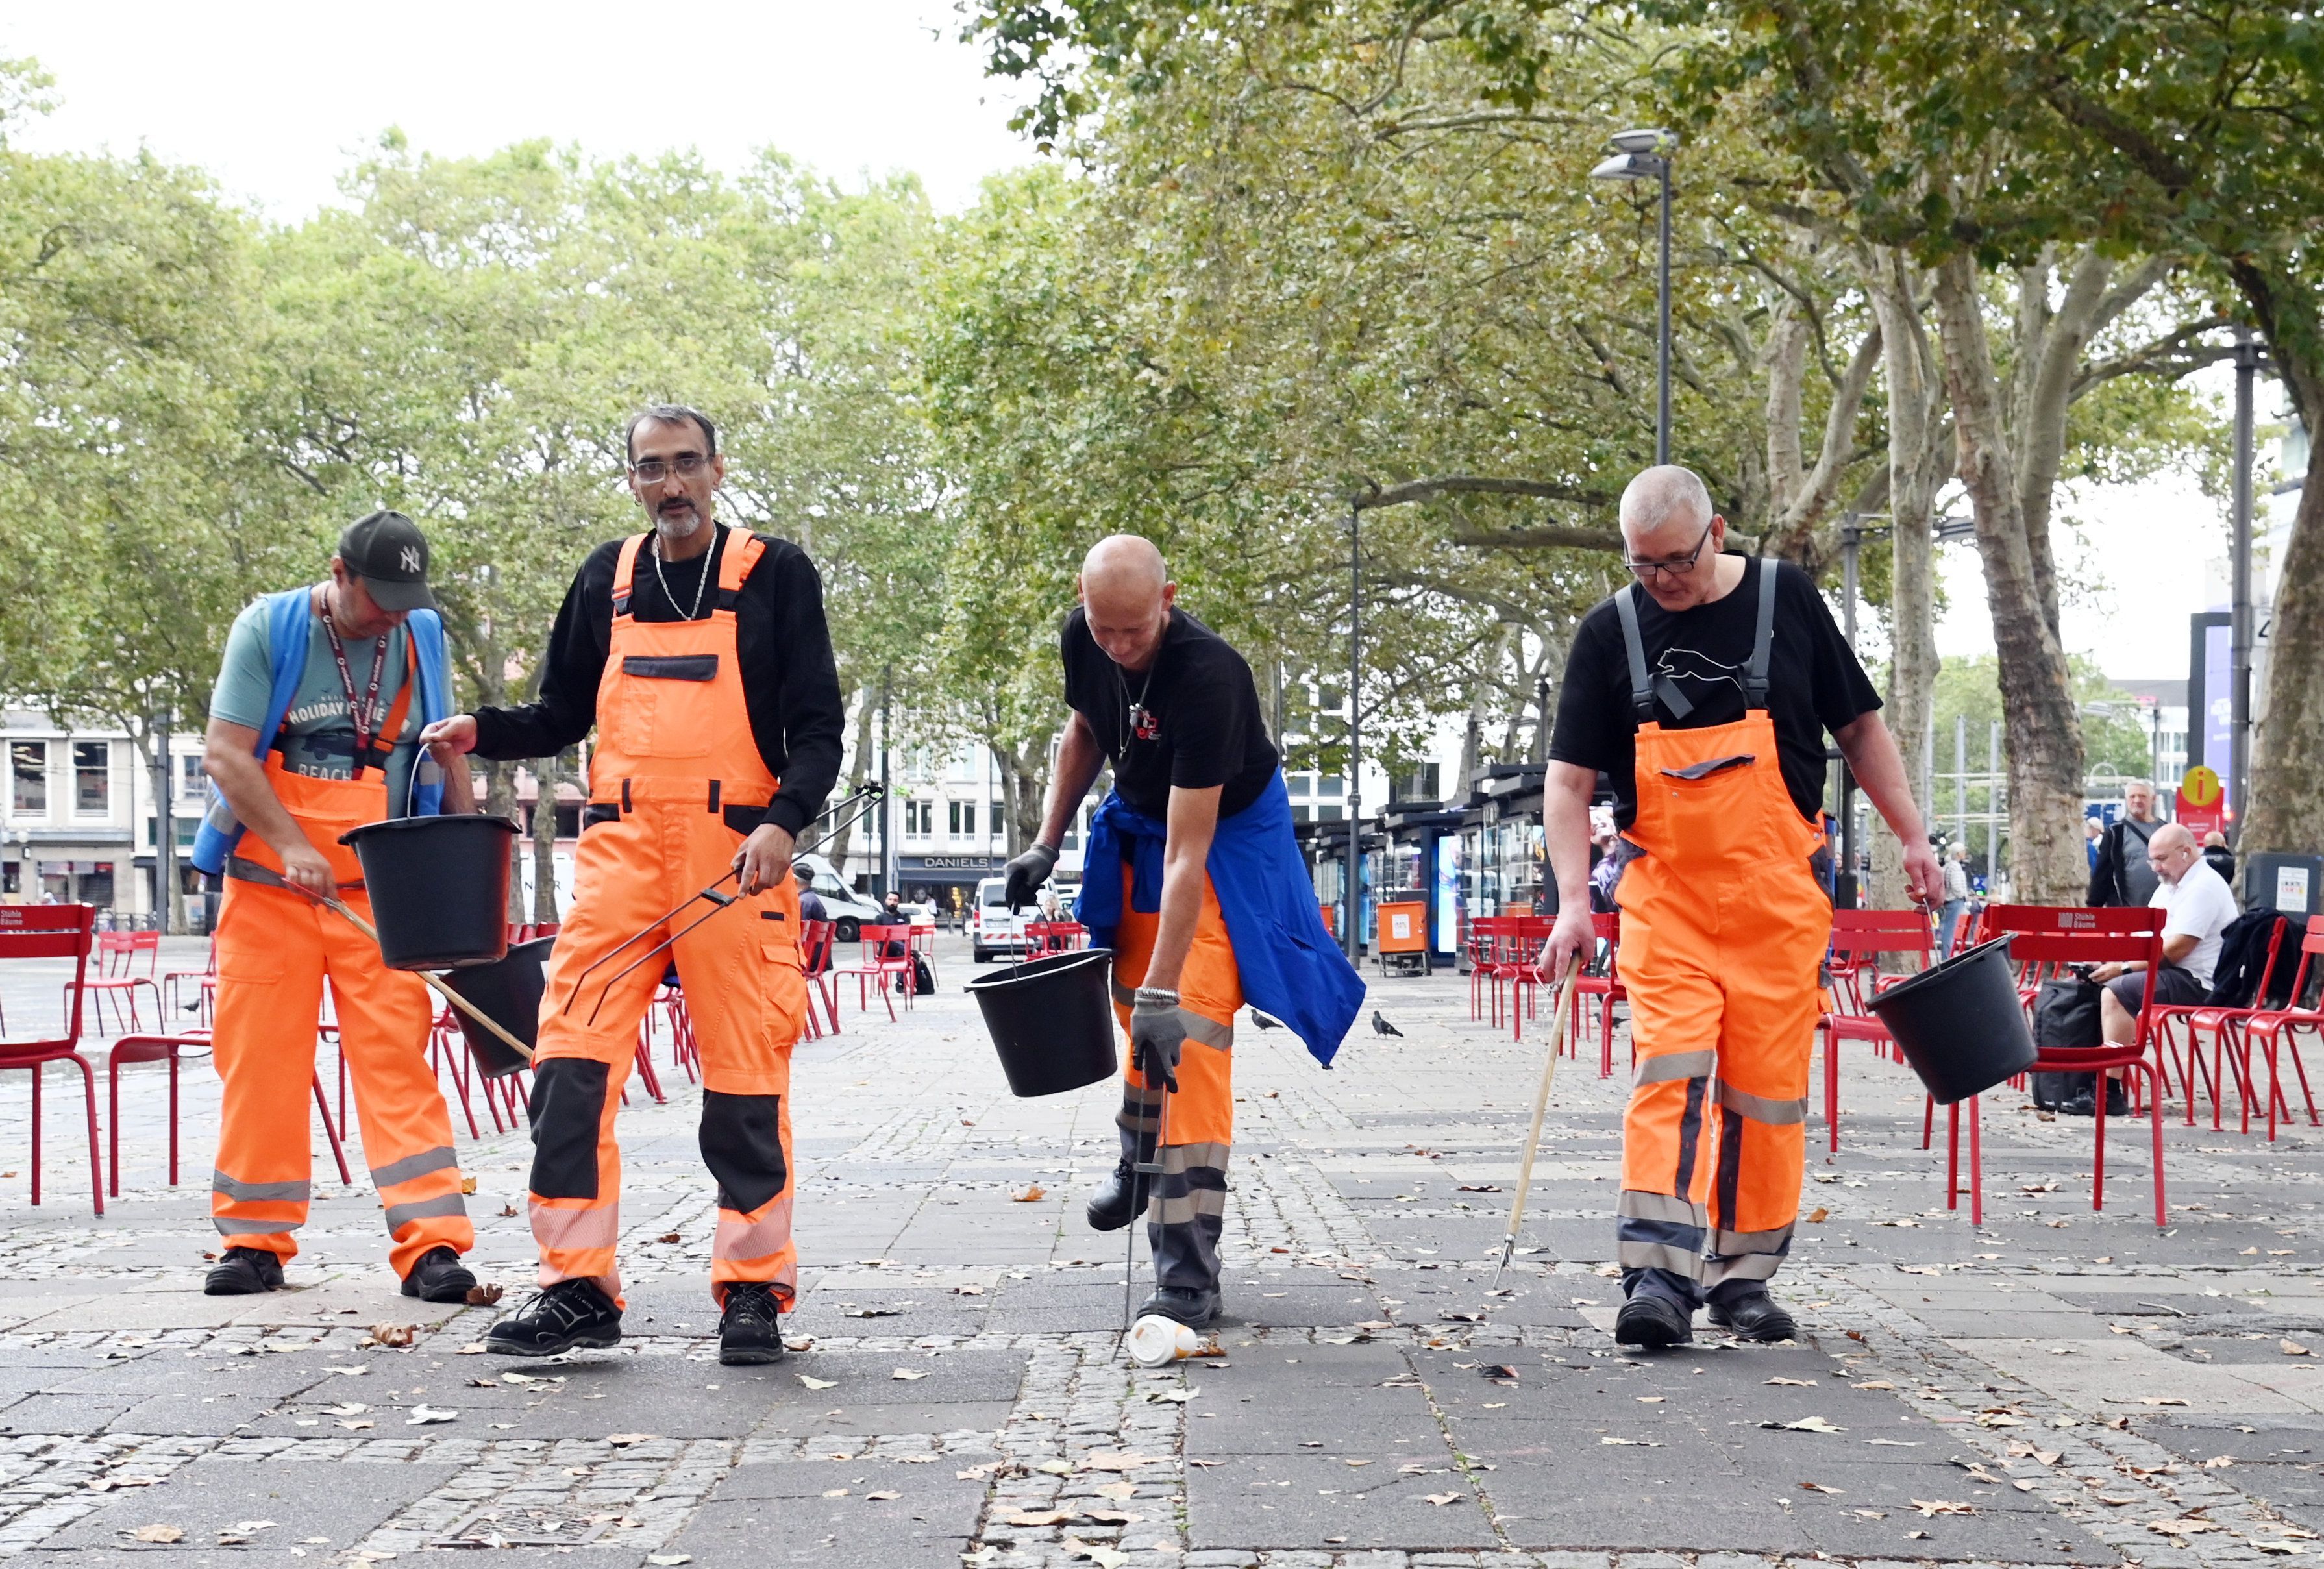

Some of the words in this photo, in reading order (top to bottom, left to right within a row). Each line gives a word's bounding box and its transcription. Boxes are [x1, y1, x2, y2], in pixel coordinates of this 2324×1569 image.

[288, 702, 344, 724] HOLIDAY
[298, 763, 353, 780] BEACH
[924, 858, 988, 867] DANIELS
